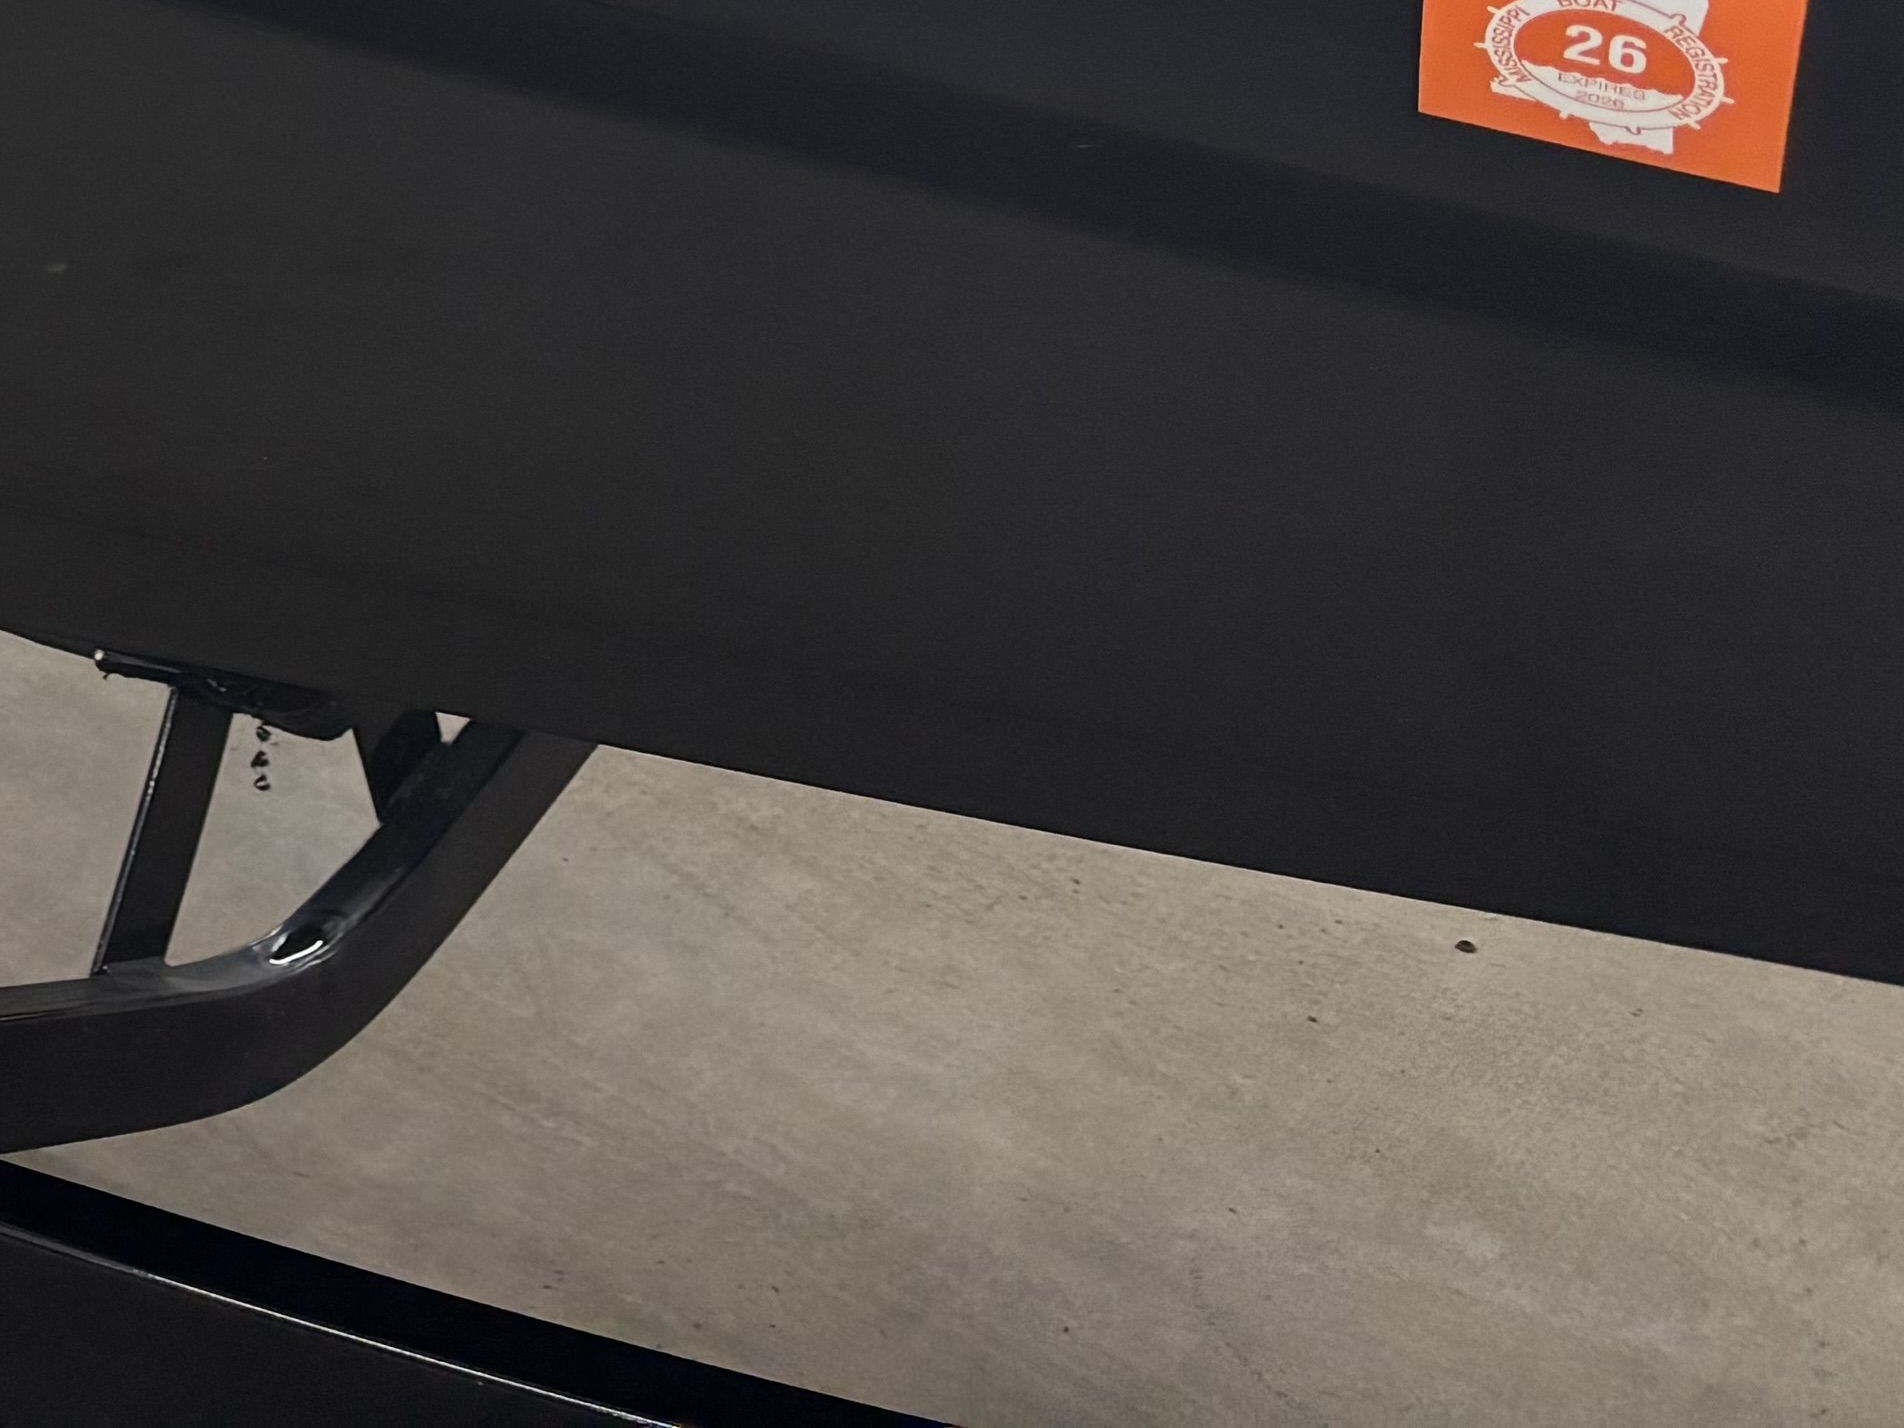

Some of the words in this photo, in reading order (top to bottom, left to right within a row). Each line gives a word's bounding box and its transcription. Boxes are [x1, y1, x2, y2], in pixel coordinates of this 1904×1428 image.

[1491, 5, 1531, 85] MISSISSIPPI
[1664, 25, 1719, 120] REGISTRATION
[1563, 24, 1647, 74] 26
